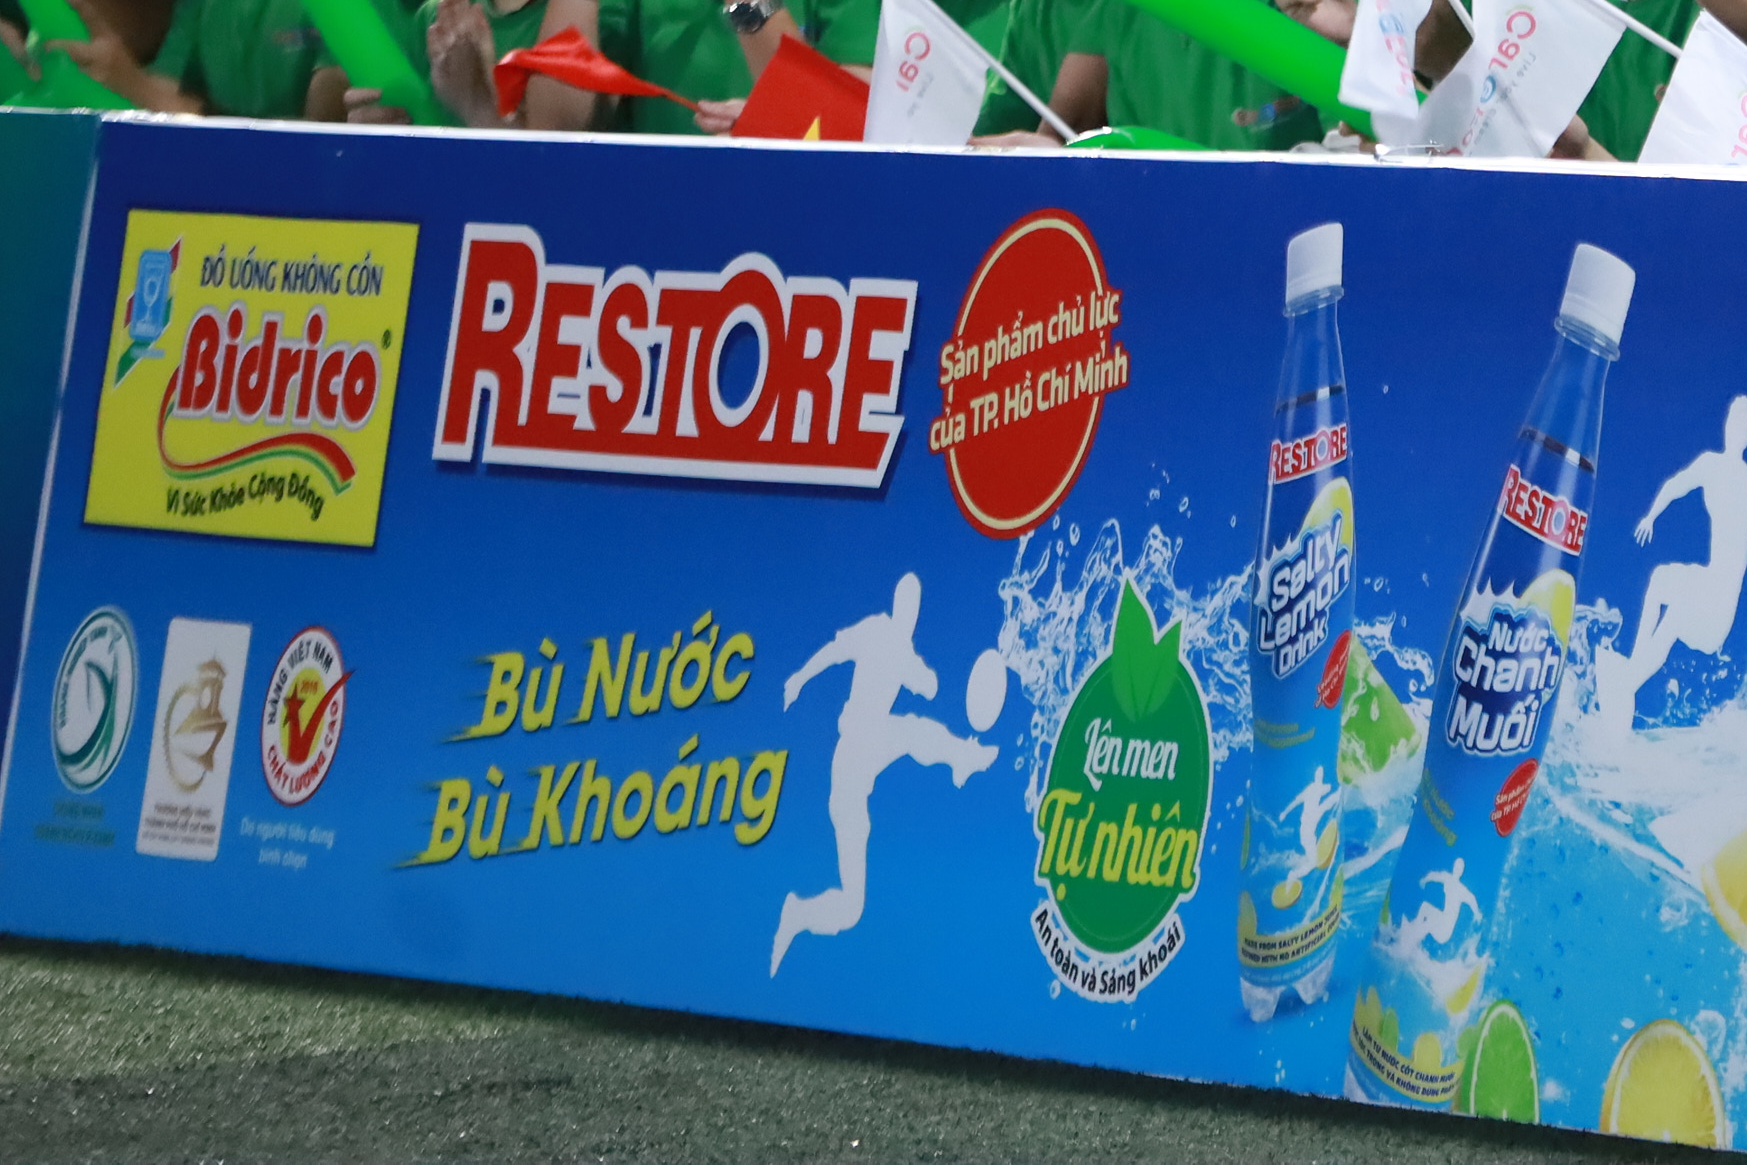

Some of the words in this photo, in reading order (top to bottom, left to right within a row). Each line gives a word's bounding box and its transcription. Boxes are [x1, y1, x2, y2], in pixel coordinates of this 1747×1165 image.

[229, 245, 278, 293] UỐNG
[280, 253, 342, 297] KHÔNG
[174, 299, 381, 430] Bidrico
[431, 222, 919, 488] RESTORE
[940, 339, 980, 385] Sản
[982, 310, 1045, 382] phẩm
[1046, 295, 1086, 345] chủ
[1088, 291, 1121, 339] lực
[929, 406, 967, 451] của
[969, 391, 999, 437] TP.
[1003, 370, 1034, 426] Hồ
[1036, 362, 1072, 412] Chí
[1073, 345, 1129, 400] Minh
[1268, 422, 1349, 485] RESTORE
[1498, 462, 1589, 557] RESTORE
[1259, 552, 1349, 651] Lemon
[1271, 515, 1342, 611] Salty
[464, 637, 566, 741] Bù
[572, 609, 756, 723] Nước
[1454, 635, 1560, 693] Chanh
[1487, 621, 1549, 655] Nước
[1083, 716, 1124, 792] Lên
[1121, 738, 1179, 781] men
[1448, 692, 1540, 751] Muối
[412, 764, 512, 868] Bù
[518, 732, 790, 847] Khoáng
[1038, 787, 1096, 902] Tự
[1086, 799, 1199, 890] nhiên
[1035, 908, 1052, 946] An
[1049, 936, 1080, 984] toàn
[1080, 965, 1097, 993] và
[1137, 921, 1182, 983] khoái
